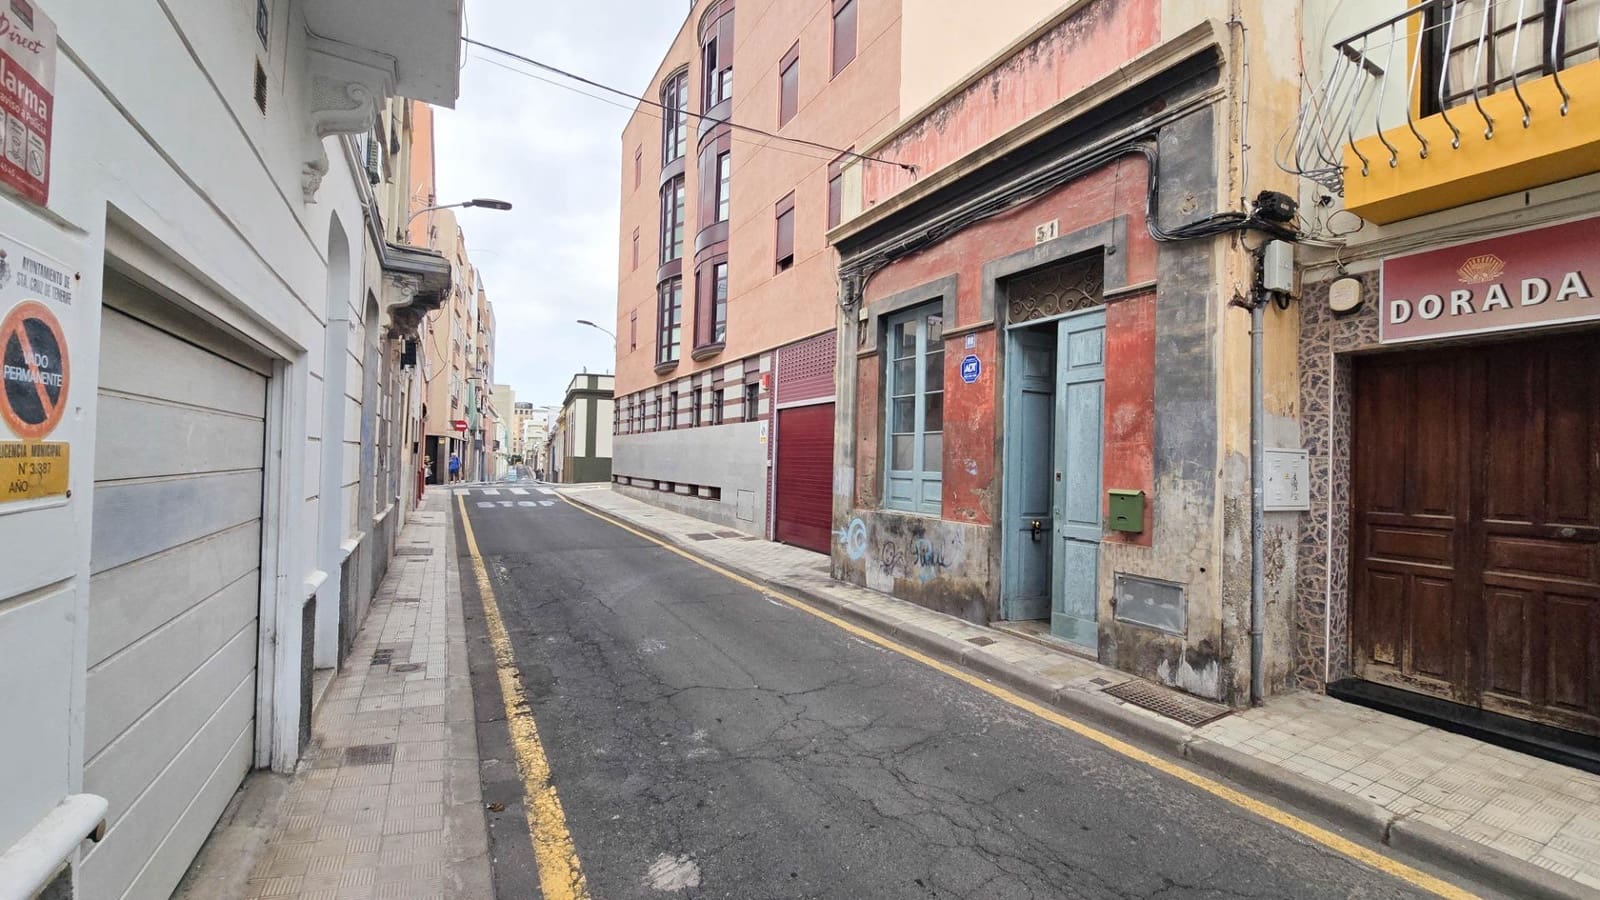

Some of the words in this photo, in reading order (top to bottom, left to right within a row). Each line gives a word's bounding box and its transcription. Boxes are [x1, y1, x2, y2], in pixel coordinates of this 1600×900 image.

[1036, 221, 1055, 243] 51
[22, 256, 63, 286] AYUNTAMIENTO
[63, 274, 71, 290] DE
[30, 277, 44, 295] CRUZ
[43, 282, 51, 298] DE
[51, 286, 72, 306] TENERIFE
[1390, 270, 1593, 324] DORADA
[24, 352, 49, 369] VADO
[4, 364, 63, 387] PERMANENTE
[31, 444, 61, 457] MUNICIPAL
[8, 478, 29, 494] AÑO
